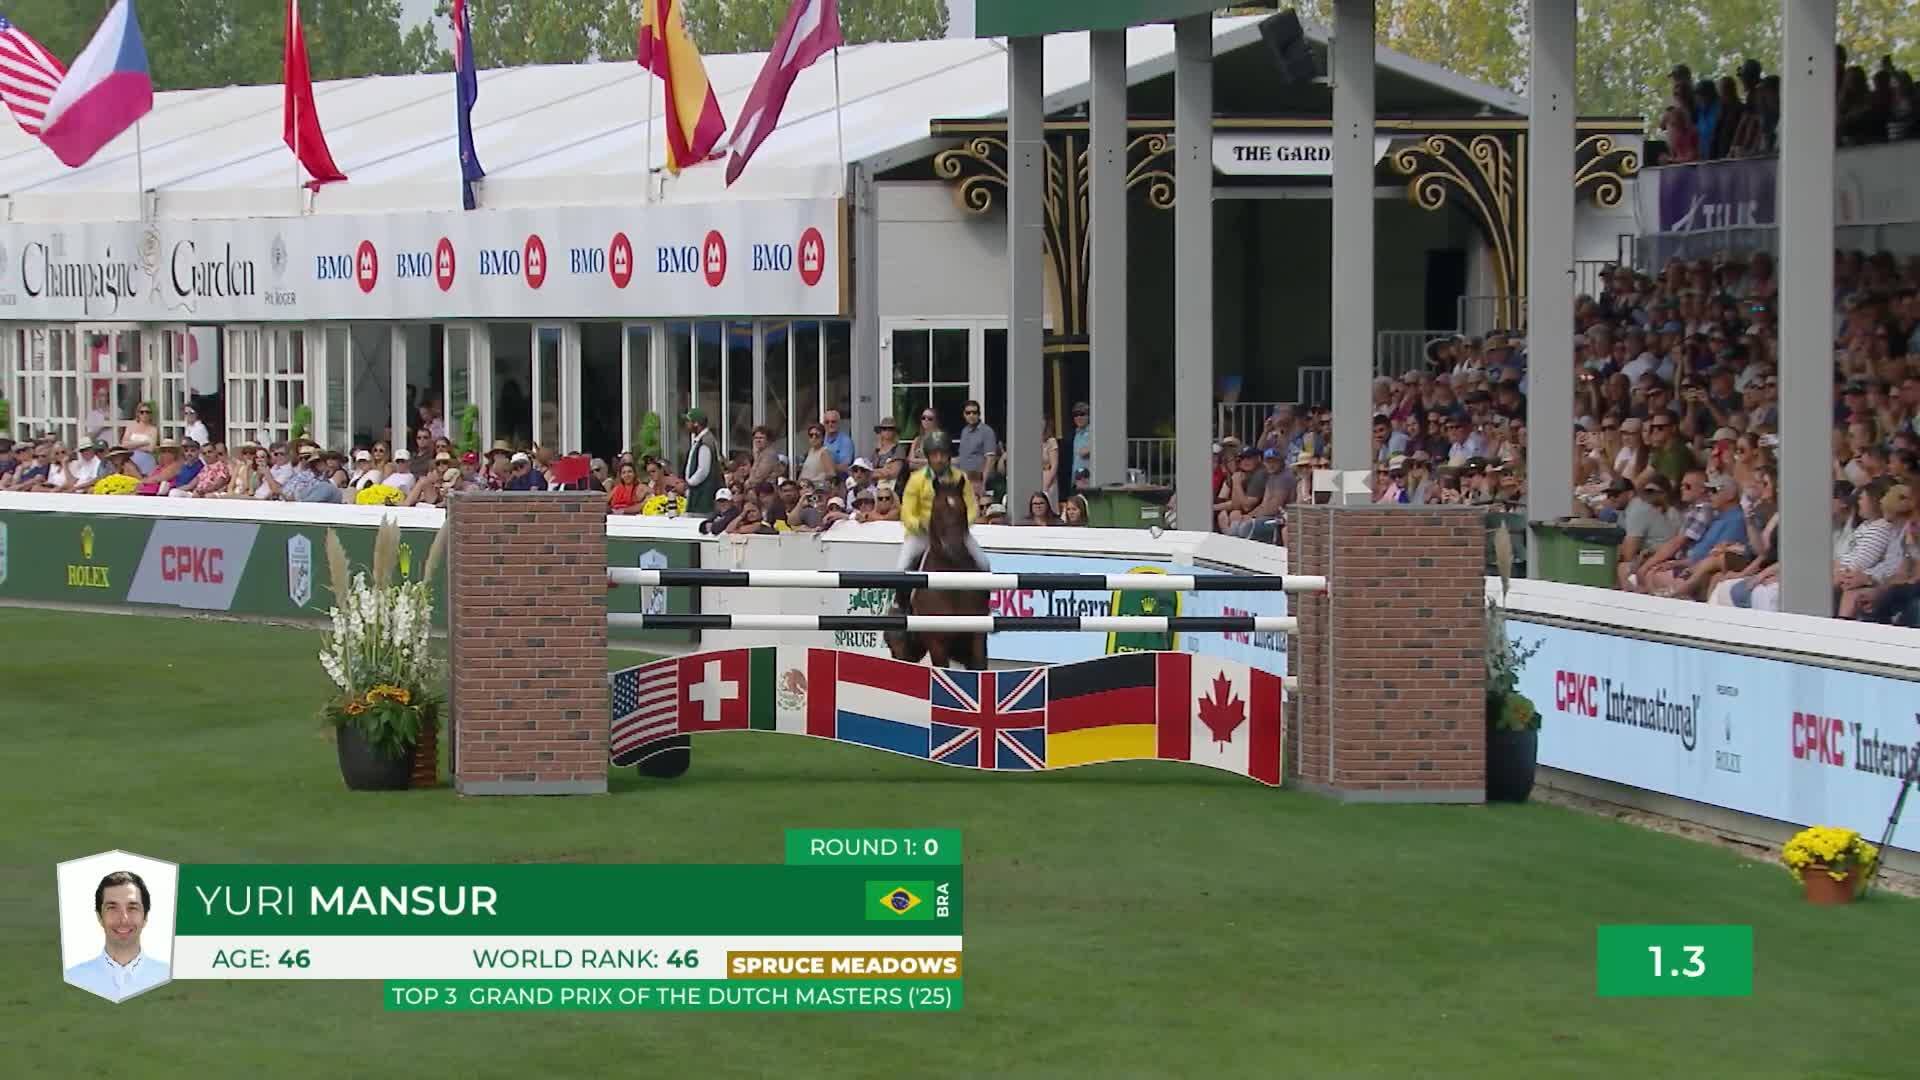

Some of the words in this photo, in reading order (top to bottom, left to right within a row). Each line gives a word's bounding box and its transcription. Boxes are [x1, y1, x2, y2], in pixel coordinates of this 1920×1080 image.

[1233, 145, 1271, 161] THE
[317, 255, 352, 279] BMO
[397, 252, 432, 278] BMO
[479, 249, 520, 275] BMO
[571, 249, 605, 273] BMO
[657, 246, 699, 273] BMO
[752, 244, 792, 271] BMO
[22, 241, 138, 315] Champagne
[171, 240, 256, 297] Garden
[67, 565, 110, 587] ROLEX
[161, 546, 224, 584] CPKC
[834, 631, 877, 648] SPRUCE
[1556, 670, 1598, 717] CPKC
[1602, 677, 1700, 751] International
[1792, 711, 1845, 767] CPKC
